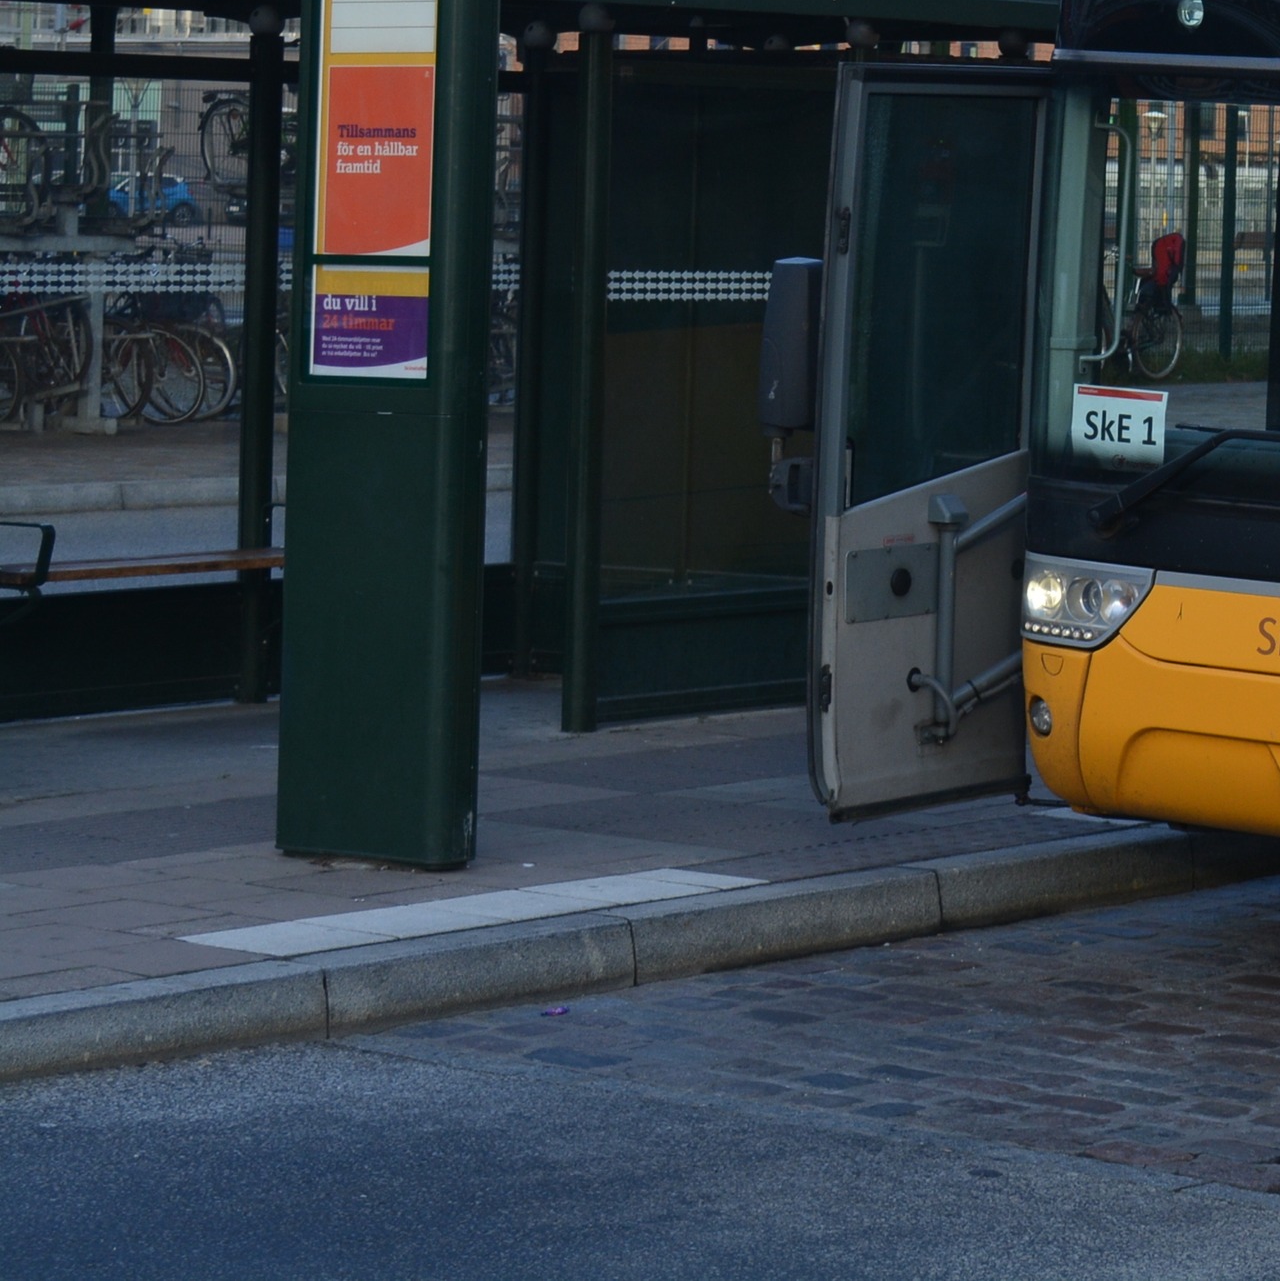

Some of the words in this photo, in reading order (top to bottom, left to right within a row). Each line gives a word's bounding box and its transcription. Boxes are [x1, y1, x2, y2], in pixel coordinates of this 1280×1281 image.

[337, 125, 417, 138] Tillsammans
[337, 141, 354, 156] för
[357, 144, 371, 156] en
[374, 141, 418, 156] hållbar
[336, 159, 381, 173] framtid
[323, 293, 341, 310] du
[345, 295, 369, 311] vill
[371, 295, 377, 311] i
[322, 313, 339, 329] 24
[342, 314, 395, 331] timmar
[1084, 410, 1132, 444] SkE
[1142, 416, 1156, 445] 1
